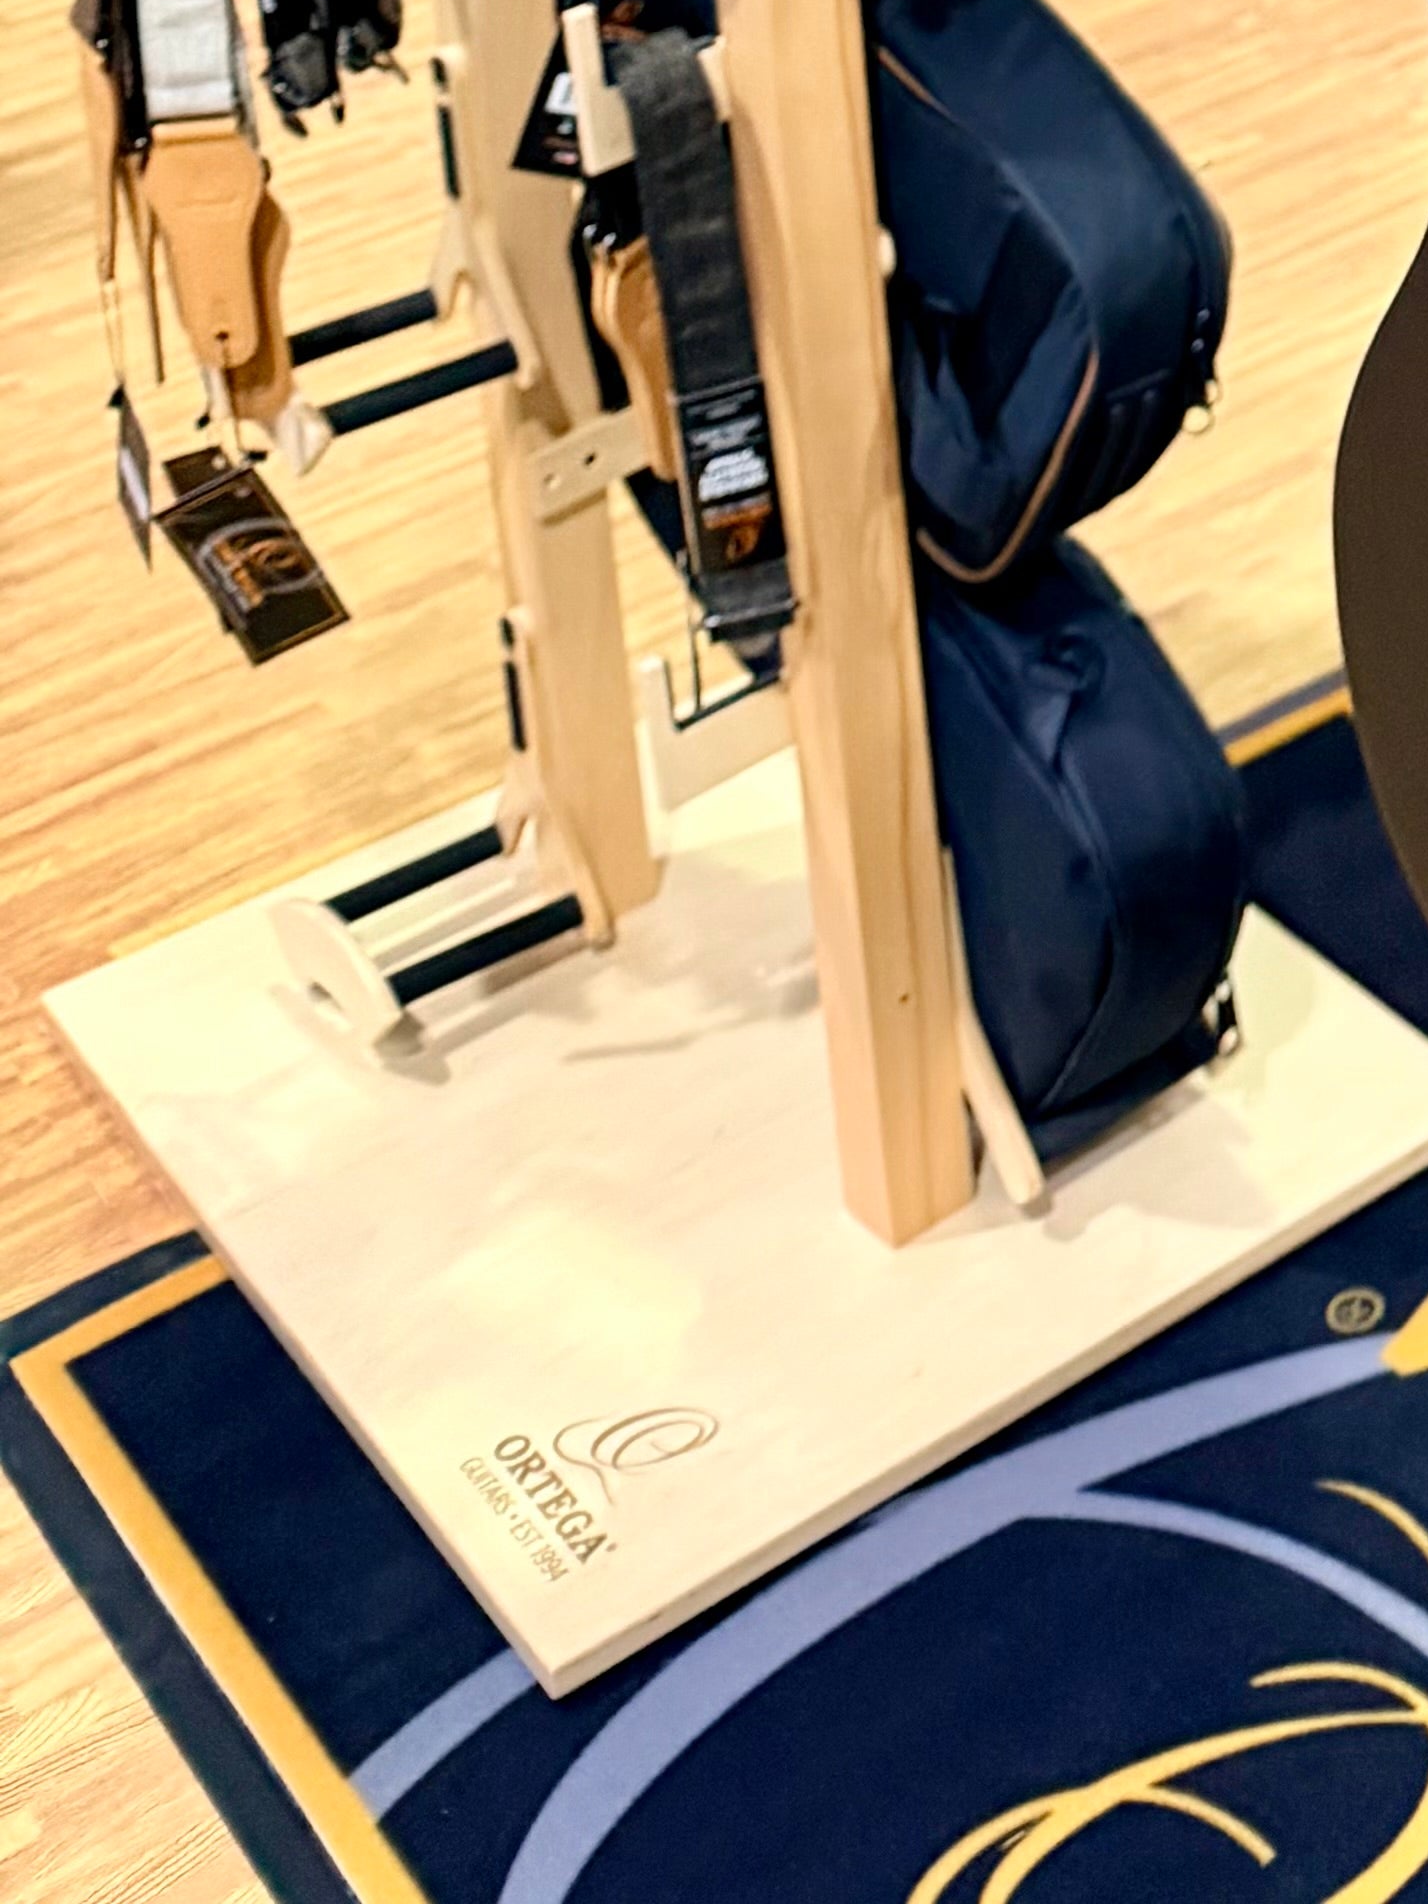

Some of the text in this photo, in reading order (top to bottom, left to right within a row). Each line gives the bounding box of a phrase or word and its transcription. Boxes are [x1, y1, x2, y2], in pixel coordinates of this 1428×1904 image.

[458, 1455, 570, 1582] GUITARS EST 1994
